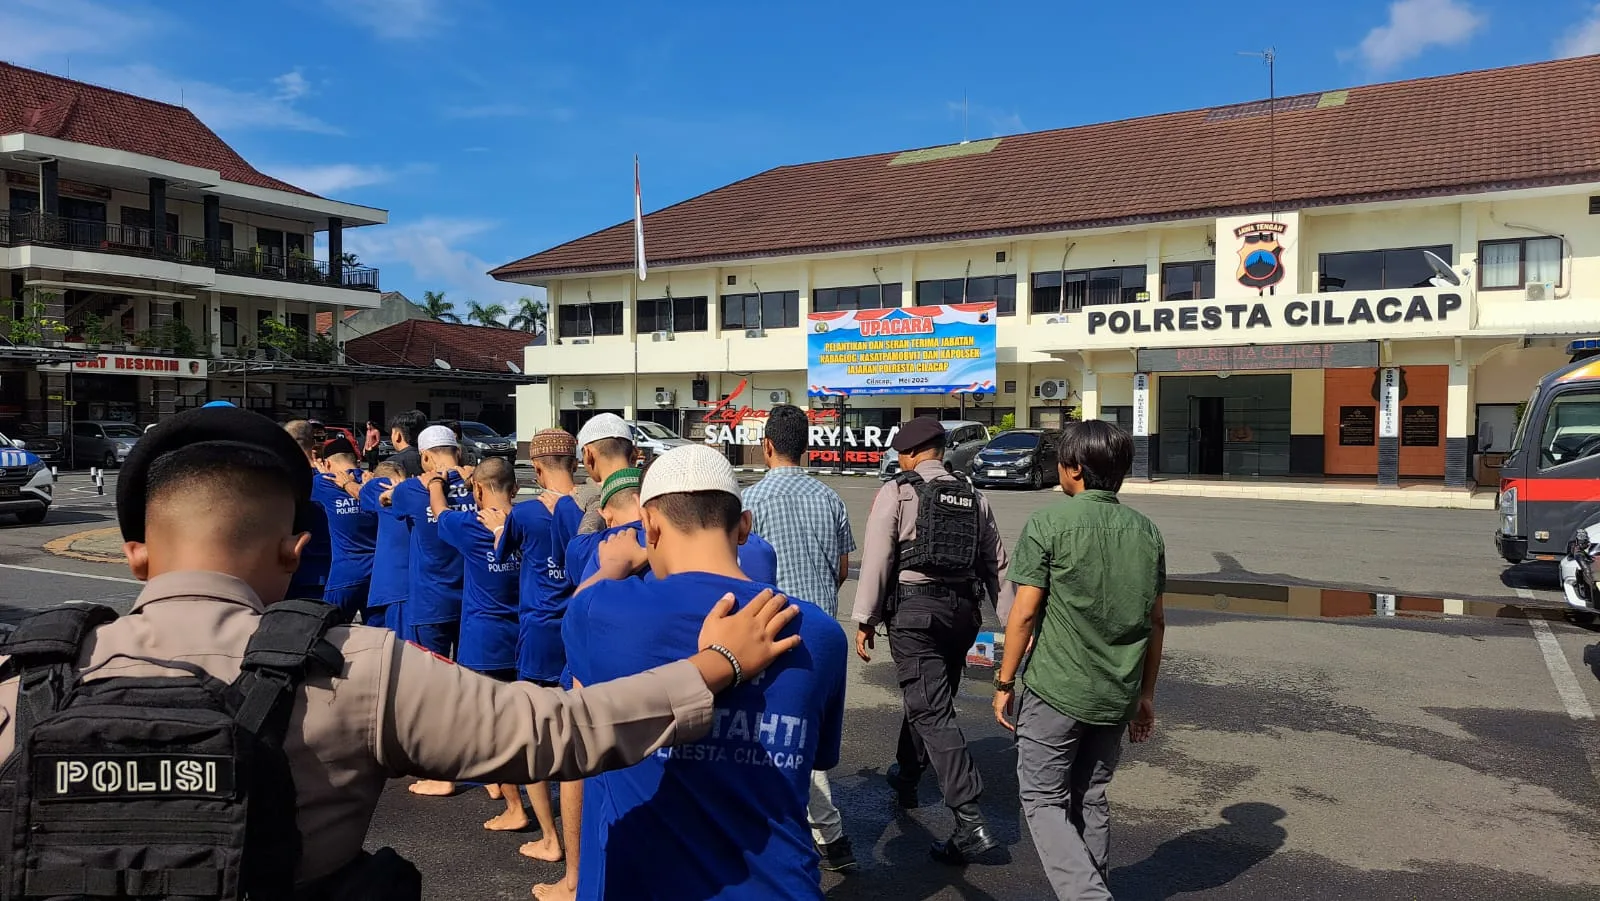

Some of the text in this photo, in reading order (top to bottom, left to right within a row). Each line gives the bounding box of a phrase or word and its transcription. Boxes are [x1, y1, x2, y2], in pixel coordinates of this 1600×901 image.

[1256, 224, 1284, 232] TENGAH
[1088, 293, 1462, 335] POLRESTA CILACAP
[860, 317, 933, 336] UPACARA
[825, 341, 867, 352] PELANTIKAN
[868, 340, 883, 350] DAN
[911, 338, 938, 348] TERIMA
[941, 336, 974, 346] JABATAN
[923, 350, 937, 360] DAN
[940, 348, 980, 359] KAPOLSEK
[1176, 344, 1333, 361] POLRESTA CILACAP
[76, 357, 179, 371] SAT RESKRIM
[848, 362, 948, 374] JAJARAN POLRESTA CILACAP
[940, 494, 972, 507] POLISI
[734, 747, 804, 770] CILACAP
[56, 760, 216, 794] POLISI
